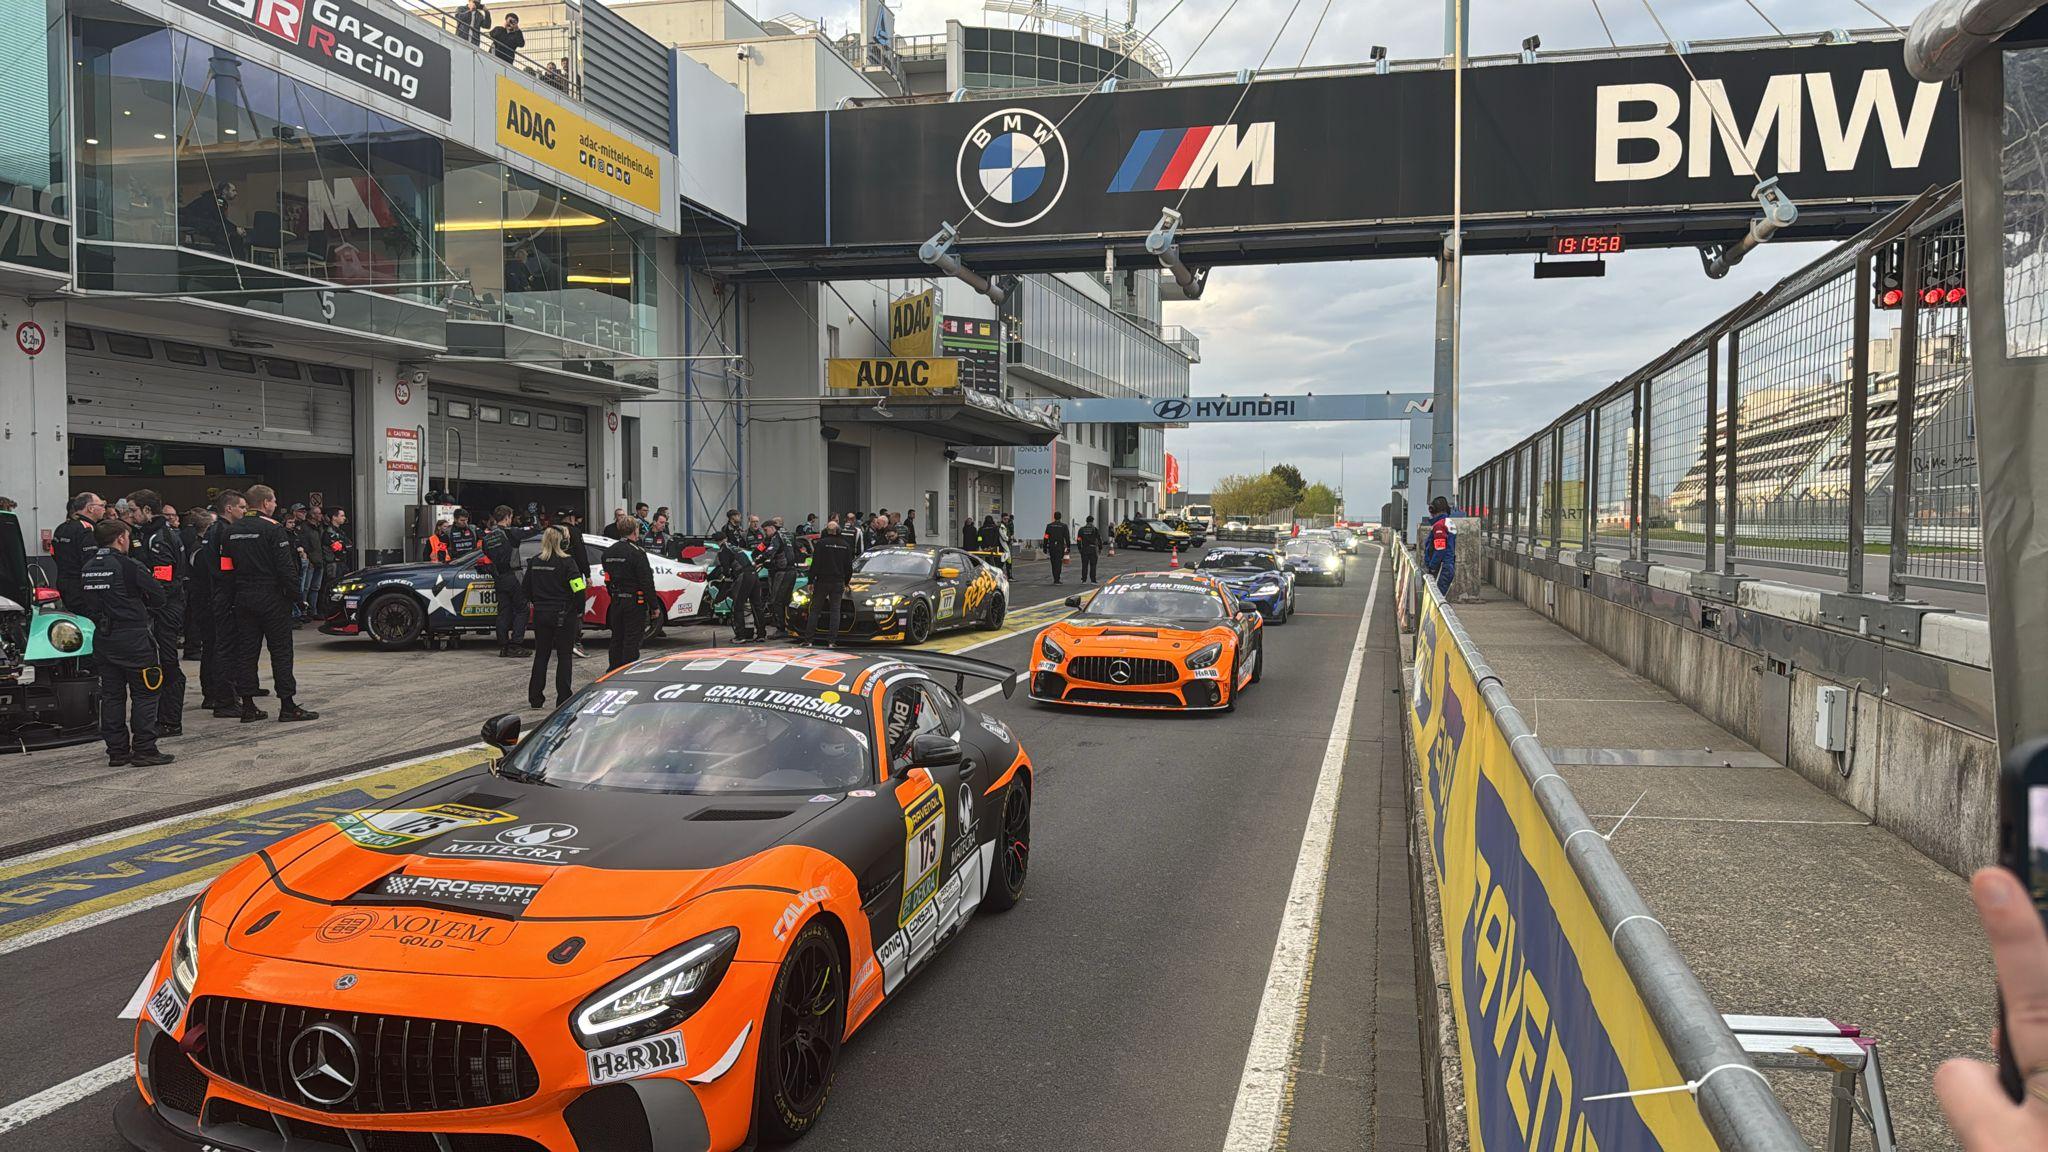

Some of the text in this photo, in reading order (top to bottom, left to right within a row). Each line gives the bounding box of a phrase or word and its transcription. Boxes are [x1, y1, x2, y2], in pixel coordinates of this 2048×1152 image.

[312, 0, 424, 68] GAZOO
[307, 24, 419, 100] Racing
[507, 100, 556, 150] ADAC
[971, 114, 1054, 149] BMW
[1594, 68, 1943, 182] BMW
[579, 134, 654, 179] adac-mittelrhein.de
[1558, 236, 1620, 253] 19:19:58
[321, 291, 336, 321] 5
[892, 295, 931, 340] ADAC
[856, 360, 929, 388] ADAC
[1196, 400, 1295, 417] HYUNDAI
[704, 684, 853, 719] GRAN TURISMO
[722, 699, 746, 707] REAL
[748, 700, 786, 712] DRIVING
[788, 706, 843, 725] SIMULATOR
[389, 817, 459, 835] 175
[911, 798, 940, 828] RAVENOL
[443, 843, 563, 860] MATECRA
[919, 823, 937, 874] 175
[912, 876, 936, 909] DEKRA
[380, 914, 496, 944] NOVEM
[772, 885, 832, 943] FALKEN
[399, 935, 444, 949] GOLD
[880, 932, 901, 964] SONIC
[591, 1046, 647, 1079] H&R
